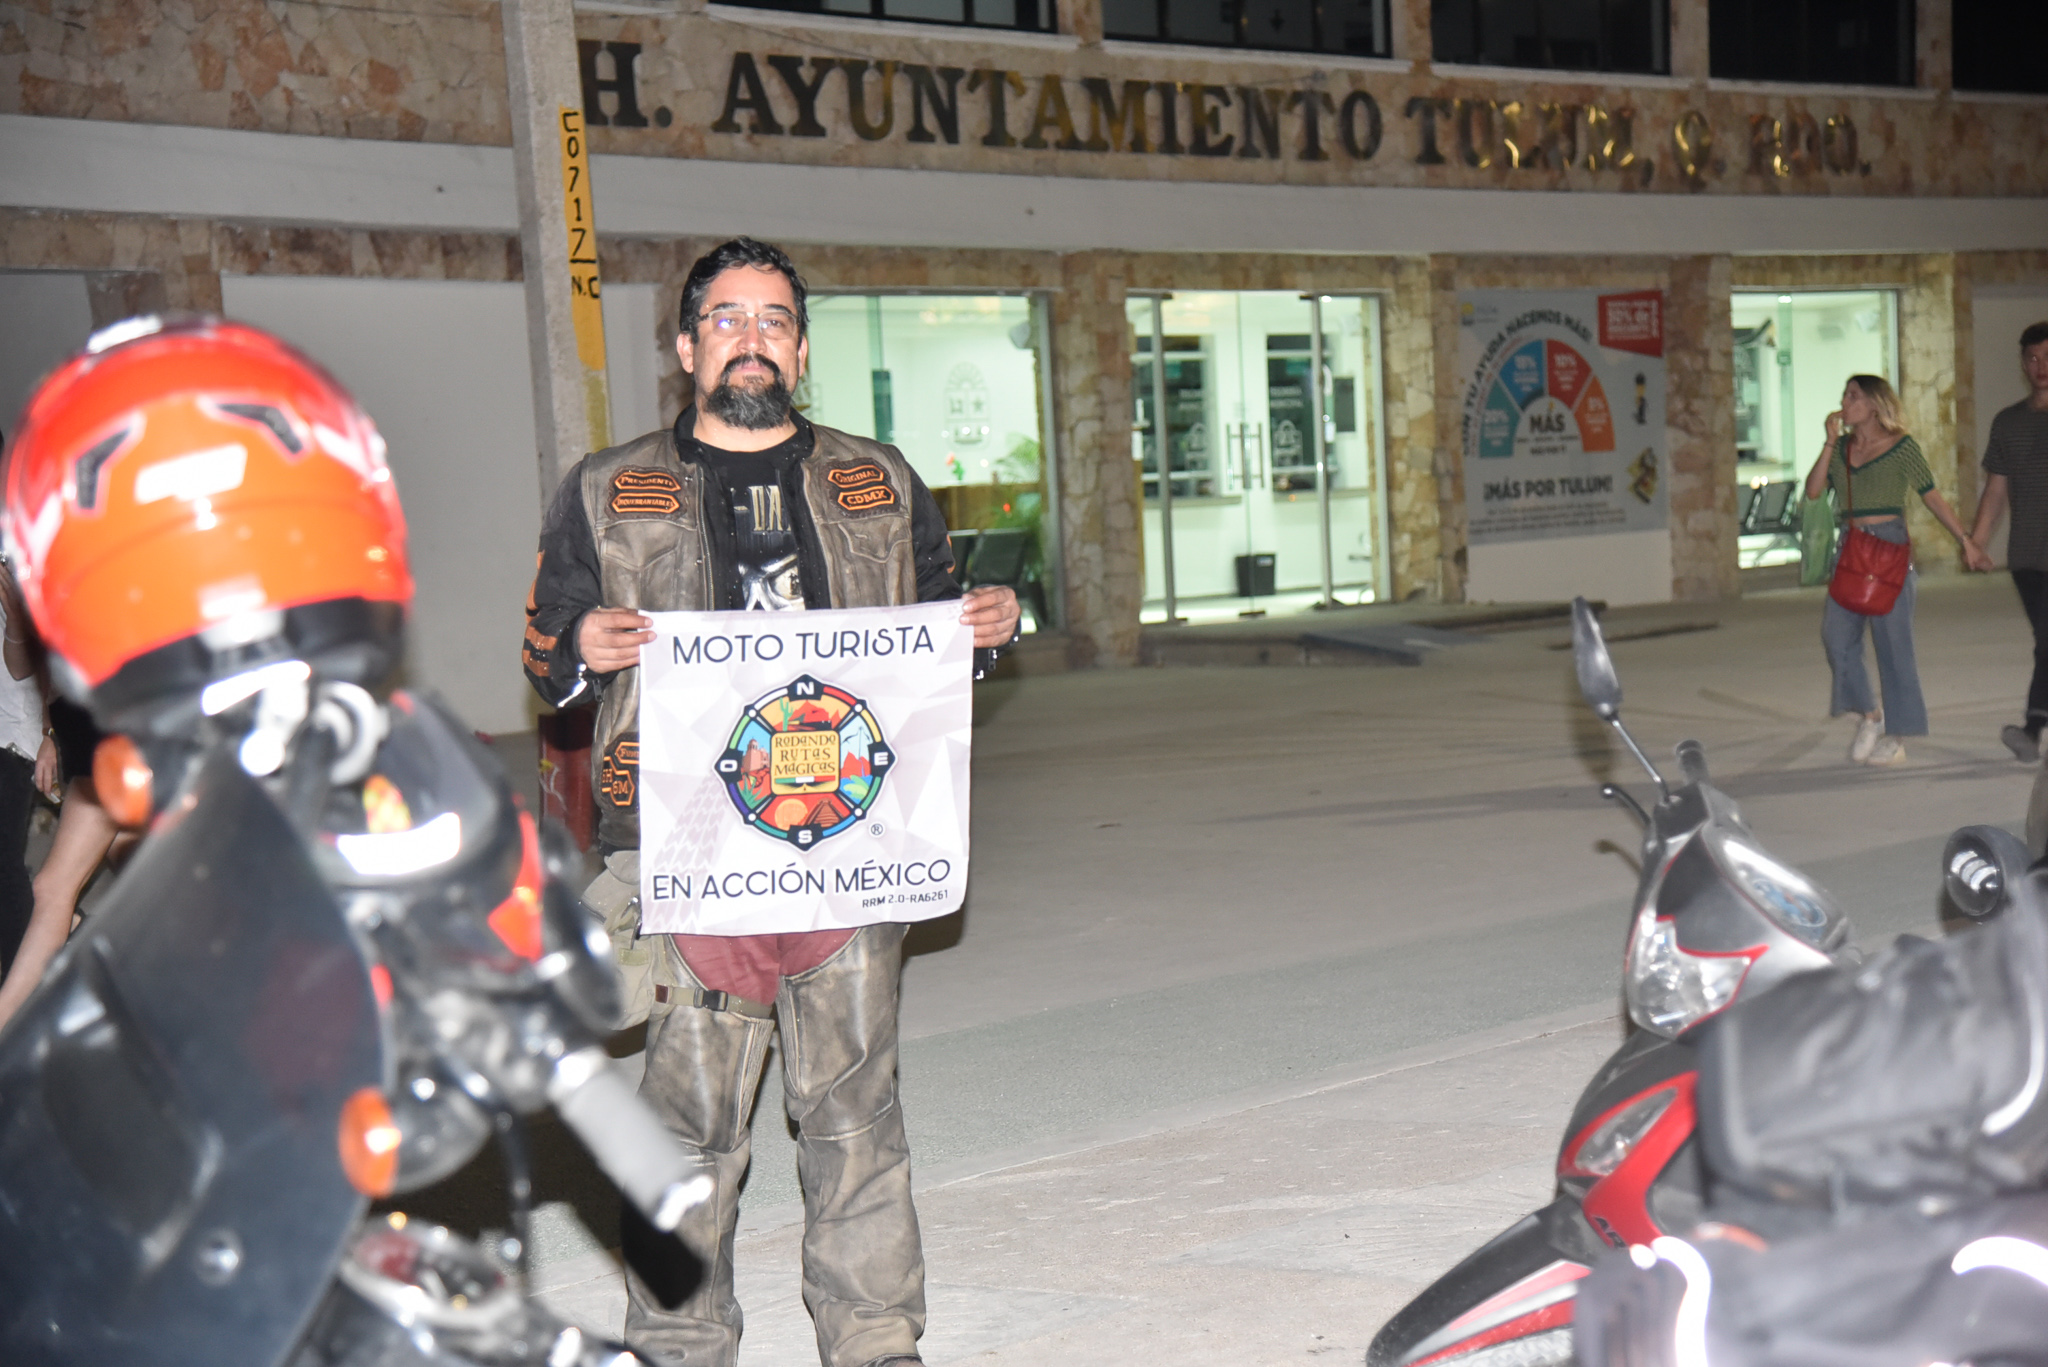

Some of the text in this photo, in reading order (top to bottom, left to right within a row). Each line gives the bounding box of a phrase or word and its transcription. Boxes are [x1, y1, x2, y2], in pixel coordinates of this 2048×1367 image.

[577, 40, 673, 128] H.
[712, 52, 1382, 162] AYUNTAMIENTO
[835, 470, 878, 483] ORIGINAL
[1525, 479, 1555, 498] POR
[846, 490, 888, 505] CDMX
[672, 625, 935, 665] MOTO TURISTA
[796, 682, 815, 696] N
[719, 759, 738, 773] O
[873, 752, 889, 767] E
[798, 829, 813, 844] S
[653, 859, 951, 901] EN ACCIÓN MÉXICO
[862, 895, 886, 908] RRM
